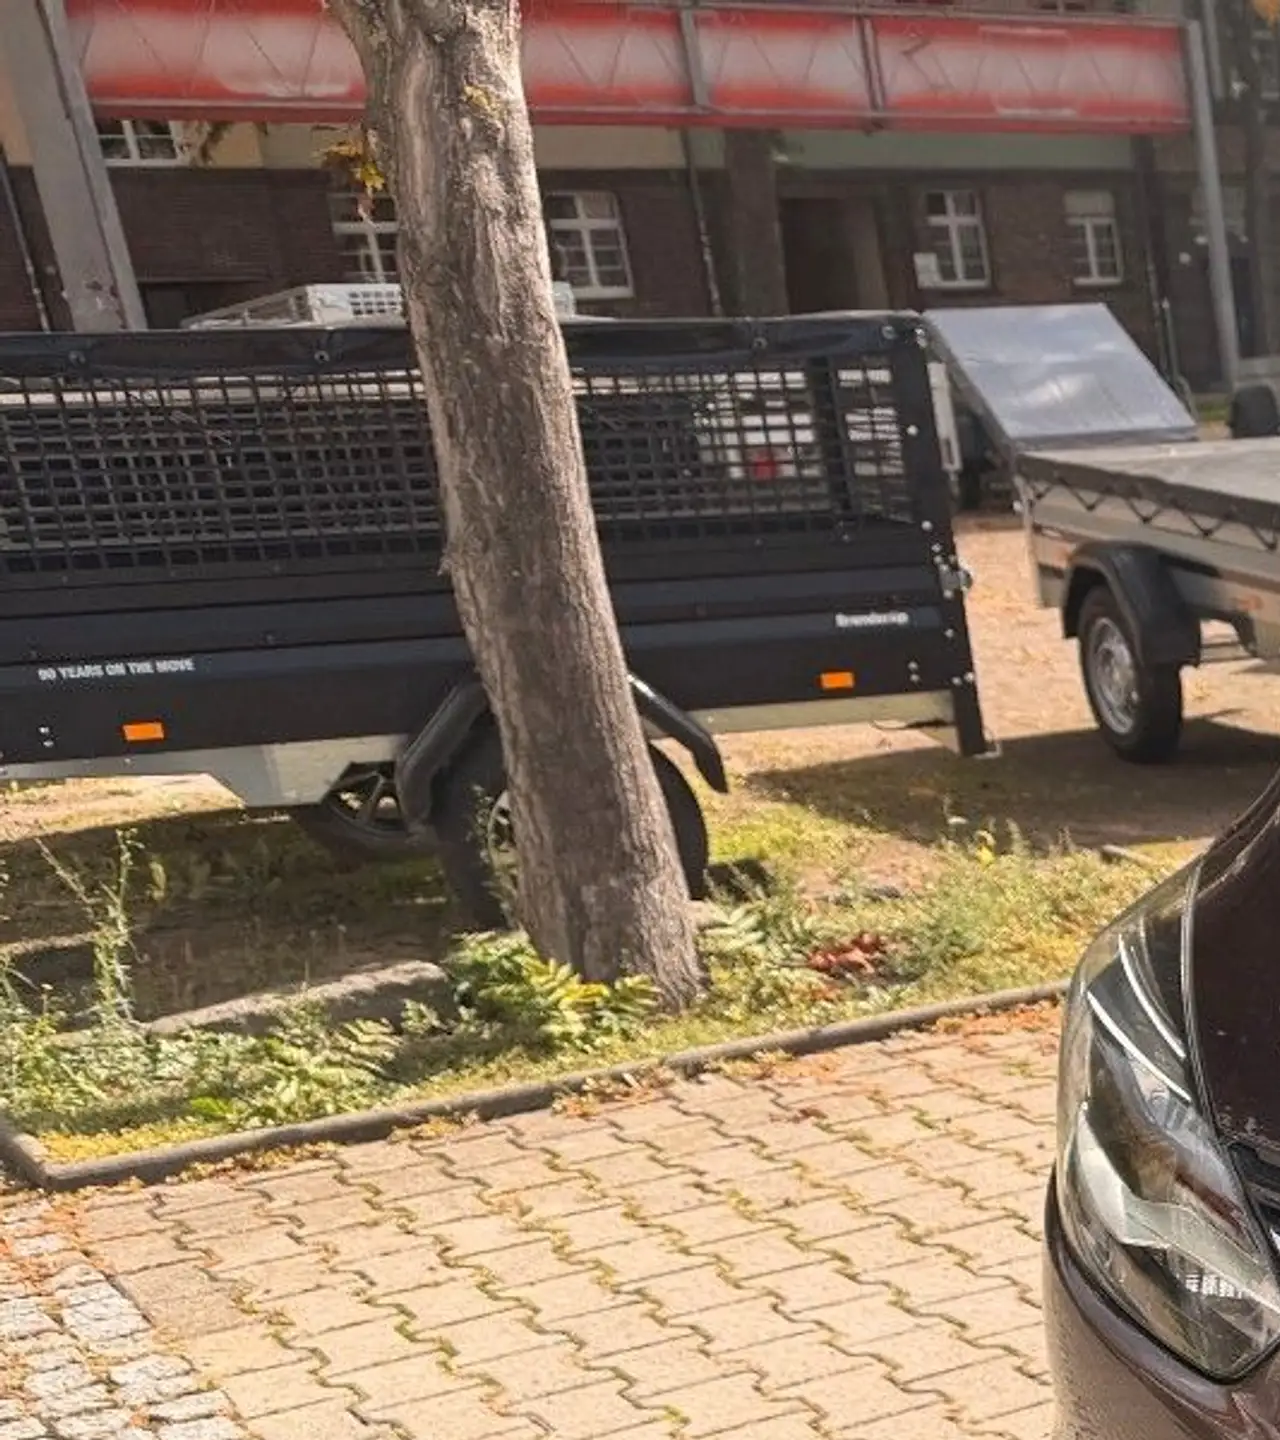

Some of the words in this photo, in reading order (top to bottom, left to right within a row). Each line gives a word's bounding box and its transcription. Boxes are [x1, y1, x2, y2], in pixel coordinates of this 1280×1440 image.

[58, 664, 104, 679] YEARS
[105, 662, 126, 676] ON
[127, 660, 154, 674] THE
[155, 658, 195, 673] MOVE
